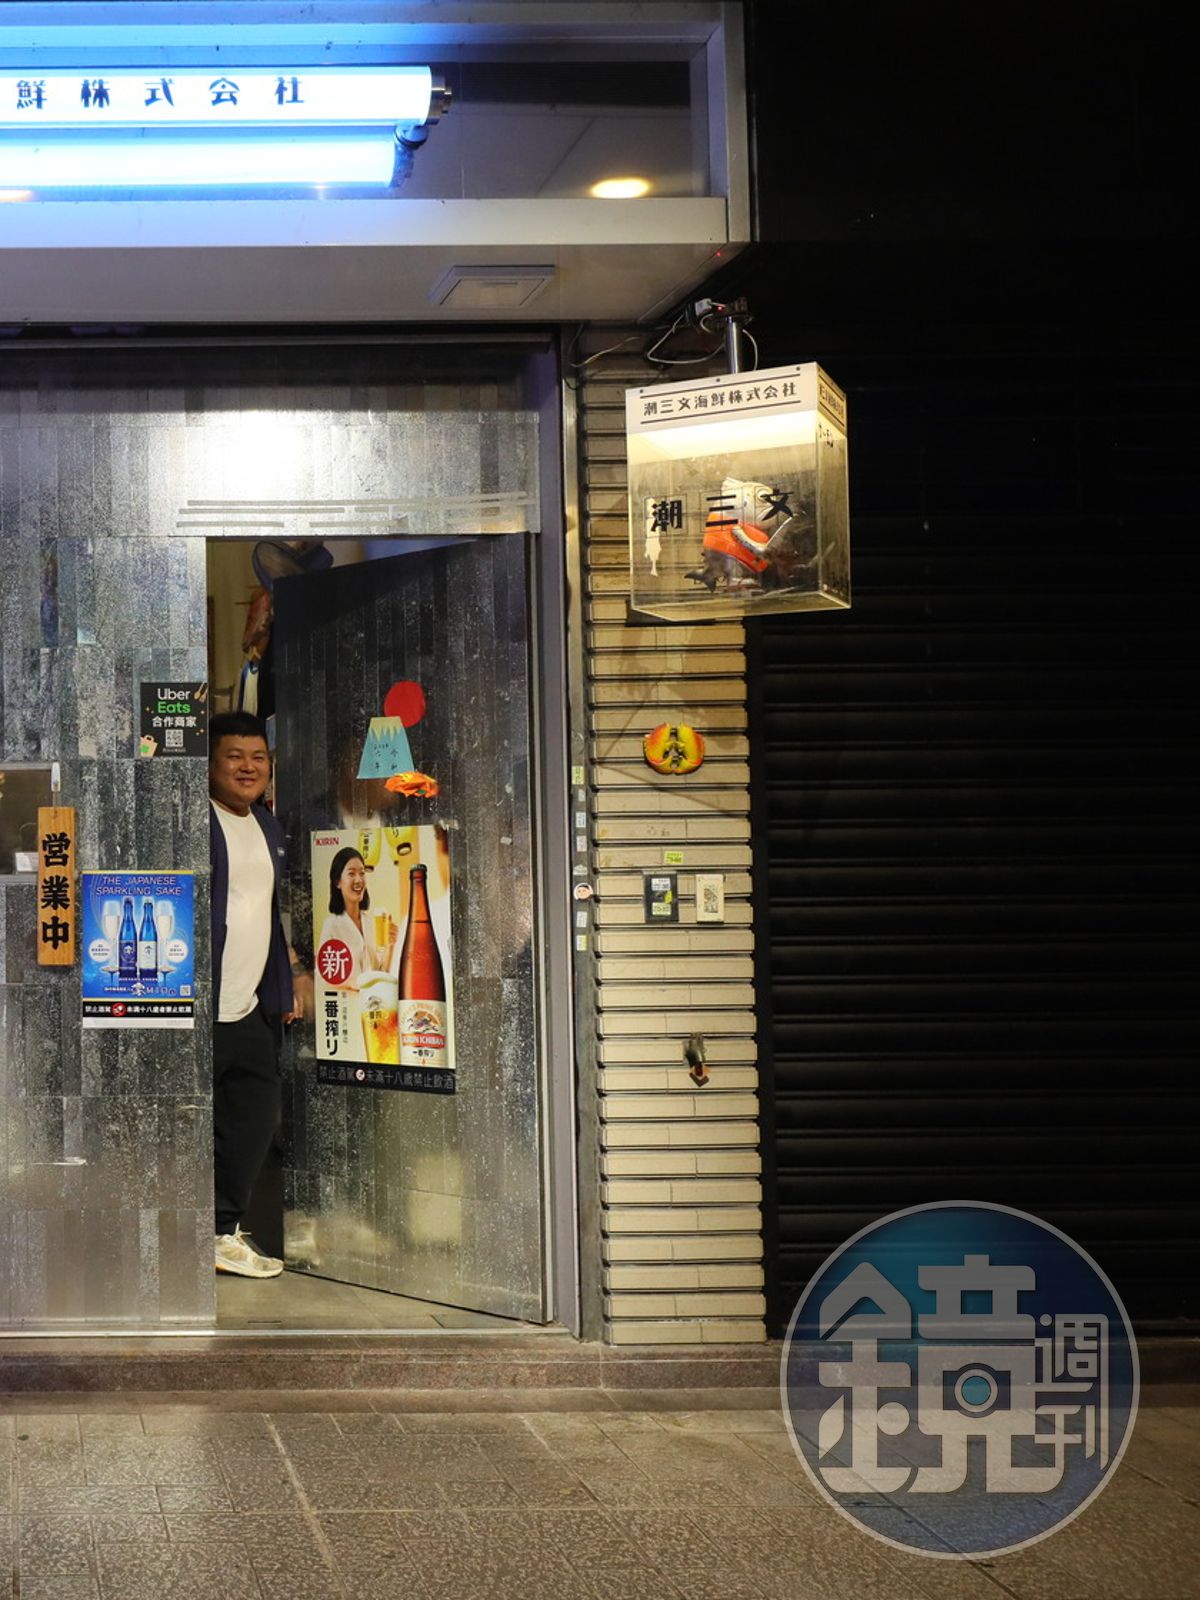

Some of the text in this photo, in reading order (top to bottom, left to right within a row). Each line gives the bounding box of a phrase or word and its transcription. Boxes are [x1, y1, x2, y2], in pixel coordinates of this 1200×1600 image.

[643, 382, 797, 417] 潮三文海鮮株式会社
[651, 489, 794, 532] 潮三文
[157, 688, 191, 700] Uber
[157, 701, 191, 713] Eats
[152, 716, 197, 727] 合作商家
[315, 837, 340, 846] KIRIN
[102, 876, 176, 885] THE JAPANESE
[41, 831, 72, 950] 営業中
[95, 886, 182, 896] SPARKLING SAKE
[322, 945, 349, 980] 新
[324, 991, 339, 1056] 一番搾り
